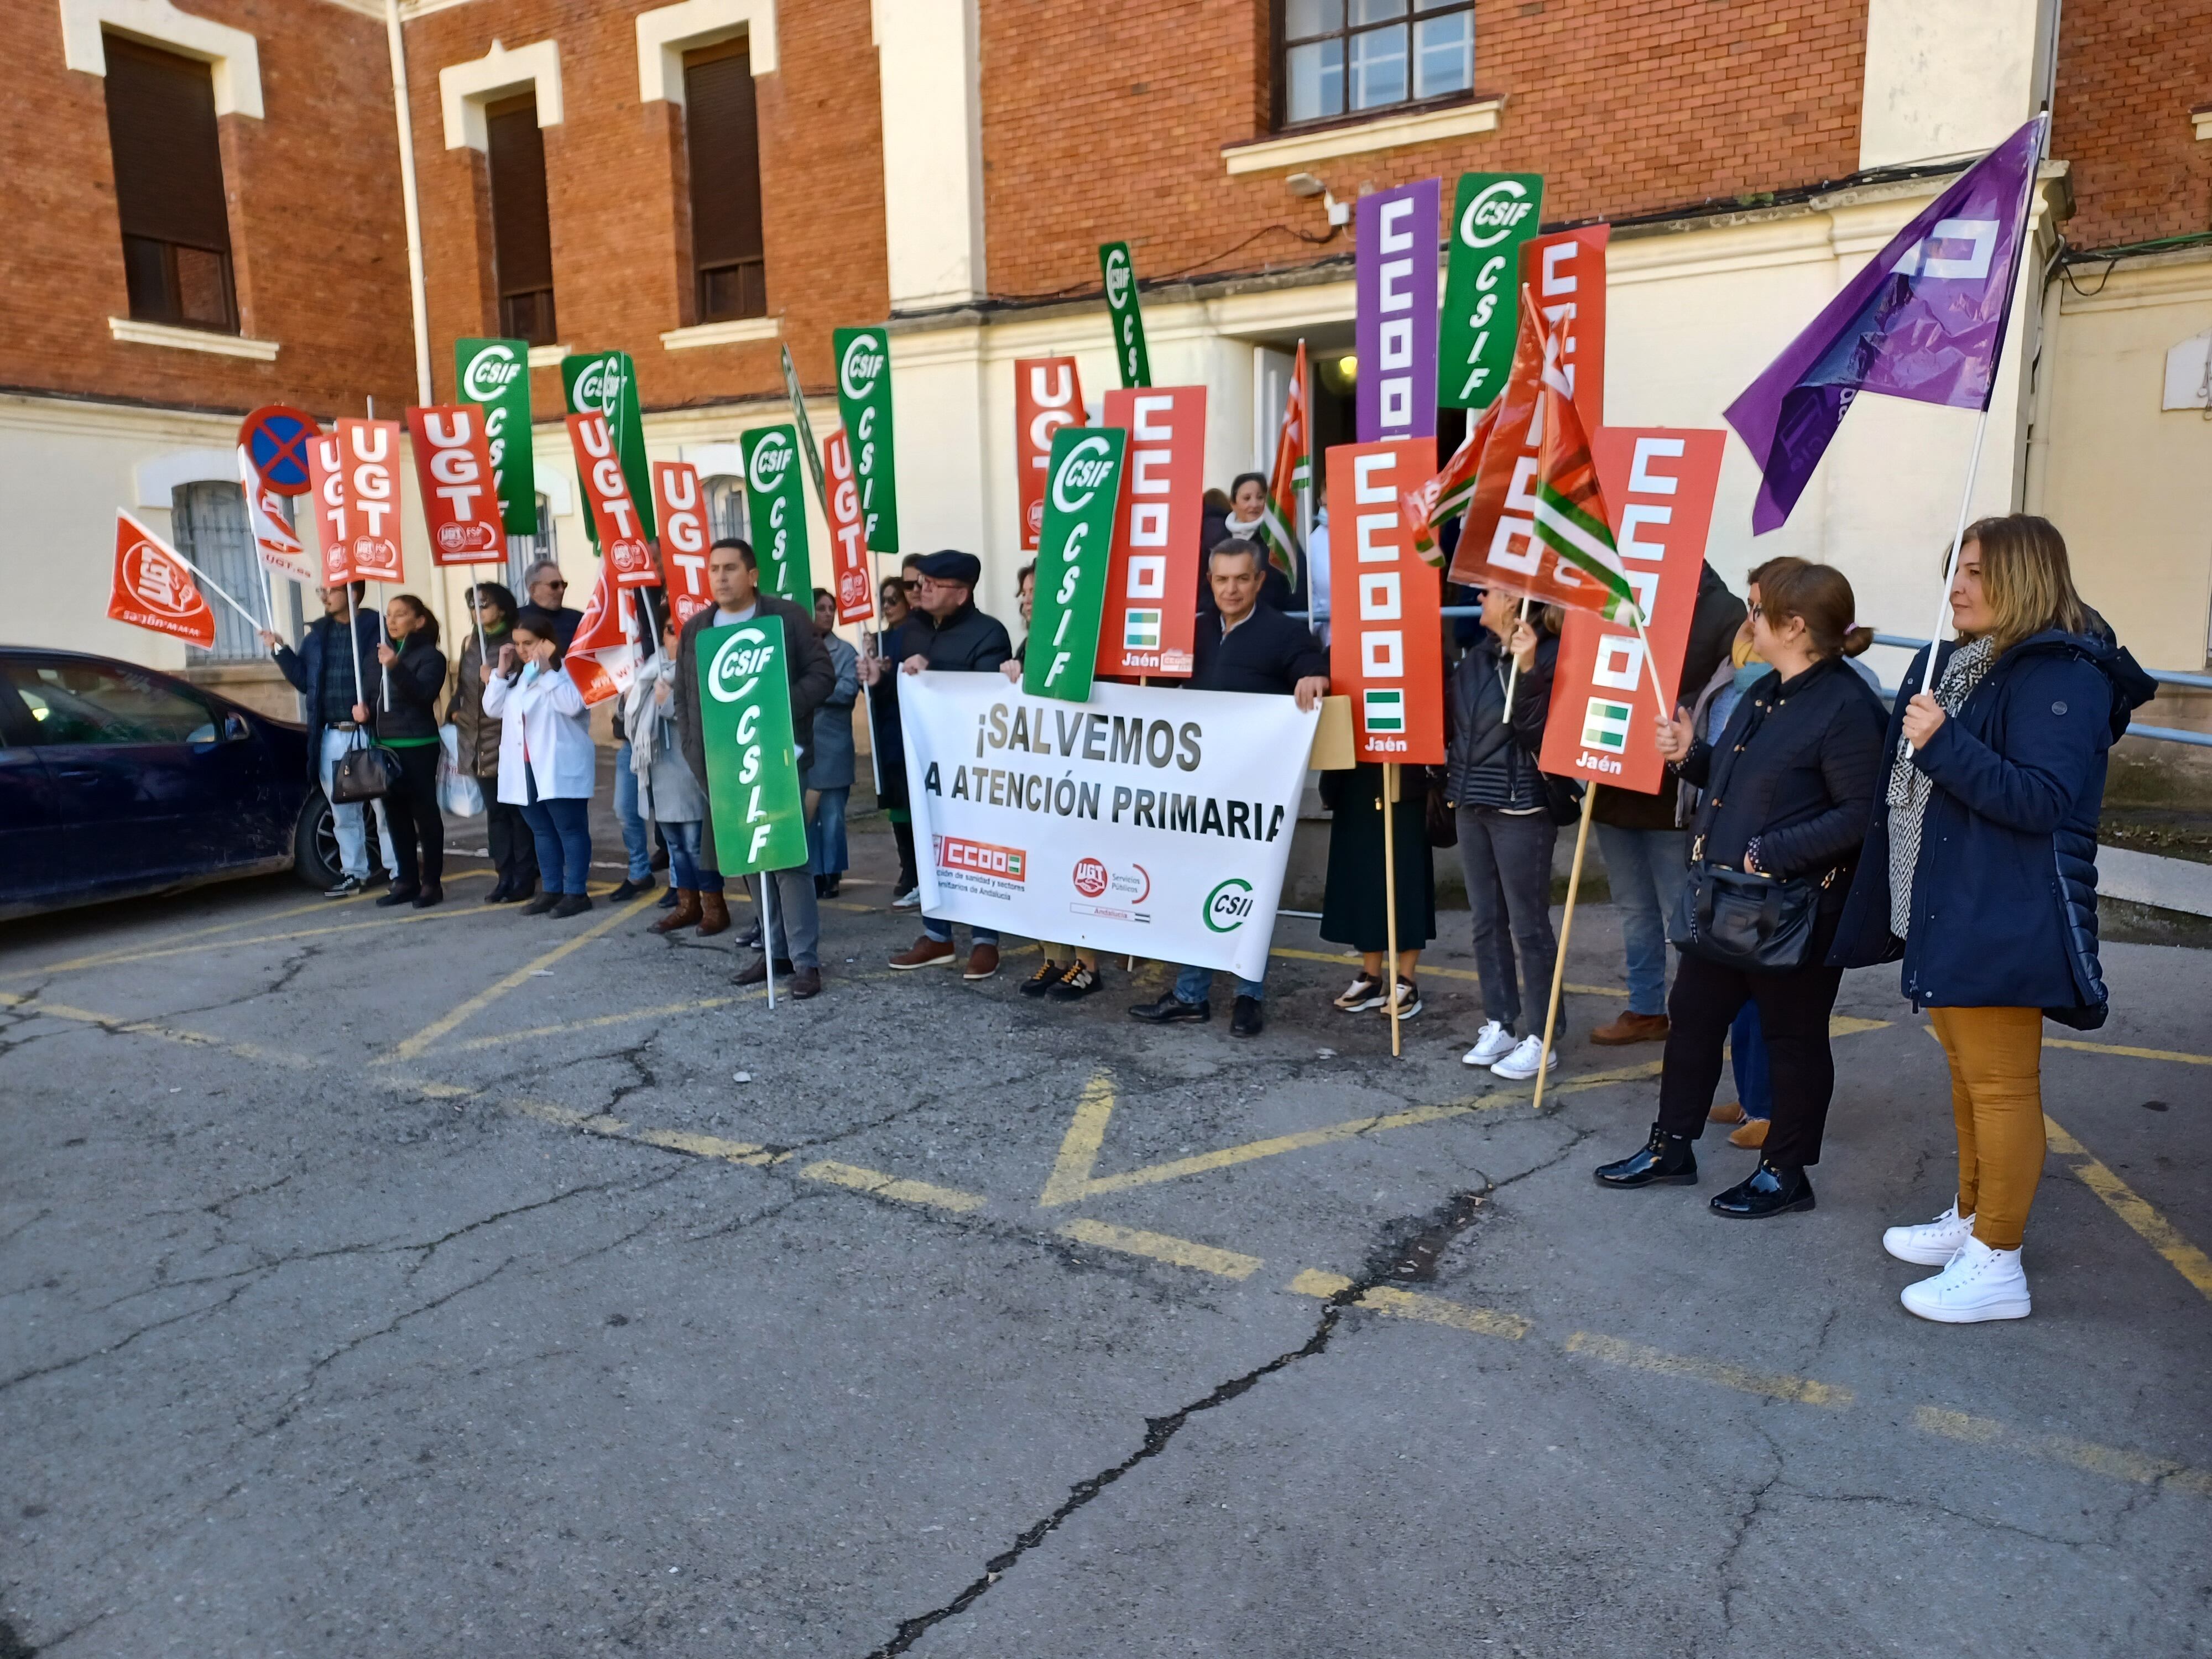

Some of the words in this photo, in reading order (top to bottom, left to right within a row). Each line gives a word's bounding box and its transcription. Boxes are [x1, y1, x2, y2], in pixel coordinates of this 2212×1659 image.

[1474, 202, 1533, 227] CSIF
[1380, 197, 1413, 428] CCOO
[1458, 255, 1506, 400] CSIF
[474, 363, 521, 383] CSIF
[849, 354, 884, 379] CSIF
[1030, 364, 1074, 469] UG
[351, 425, 390, 537] UGT
[423, 411, 481, 521] UGT
[578, 418, 632, 539] UGT
[758, 448, 793, 474] CSIF
[858, 405, 879, 544] CSIF
[1065, 459, 1115, 488] CSIF
[830, 436, 861, 570] UGT
[1126, 394, 1175, 599] CCOO
[662, 468, 707, 596] UGT
[1354, 451, 1405, 678] CCOO
[137, 545, 171, 606] UGT
[1044, 521, 1089, 687] CSIF
[721, 645, 775, 680] CSIF
[1121, 652, 1160, 667] Jaén
[976, 703, 1202, 773] ¡SALVEMOS
[1365, 736, 1407, 753] Jaén
[1575, 751, 1622, 775] Jaén
[736, 705, 772, 864] CSIF
[951, 764, 1101, 821] ATENCIÓN
[1112, 785, 1285, 843] PRIMARIA
[947, 842, 1008, 872] CCOO
[1077, 863, 1104, 882] UGT
[1112, 873, 1140, 885] Servicios
[1112, 883, 1138, 894] Públicos
